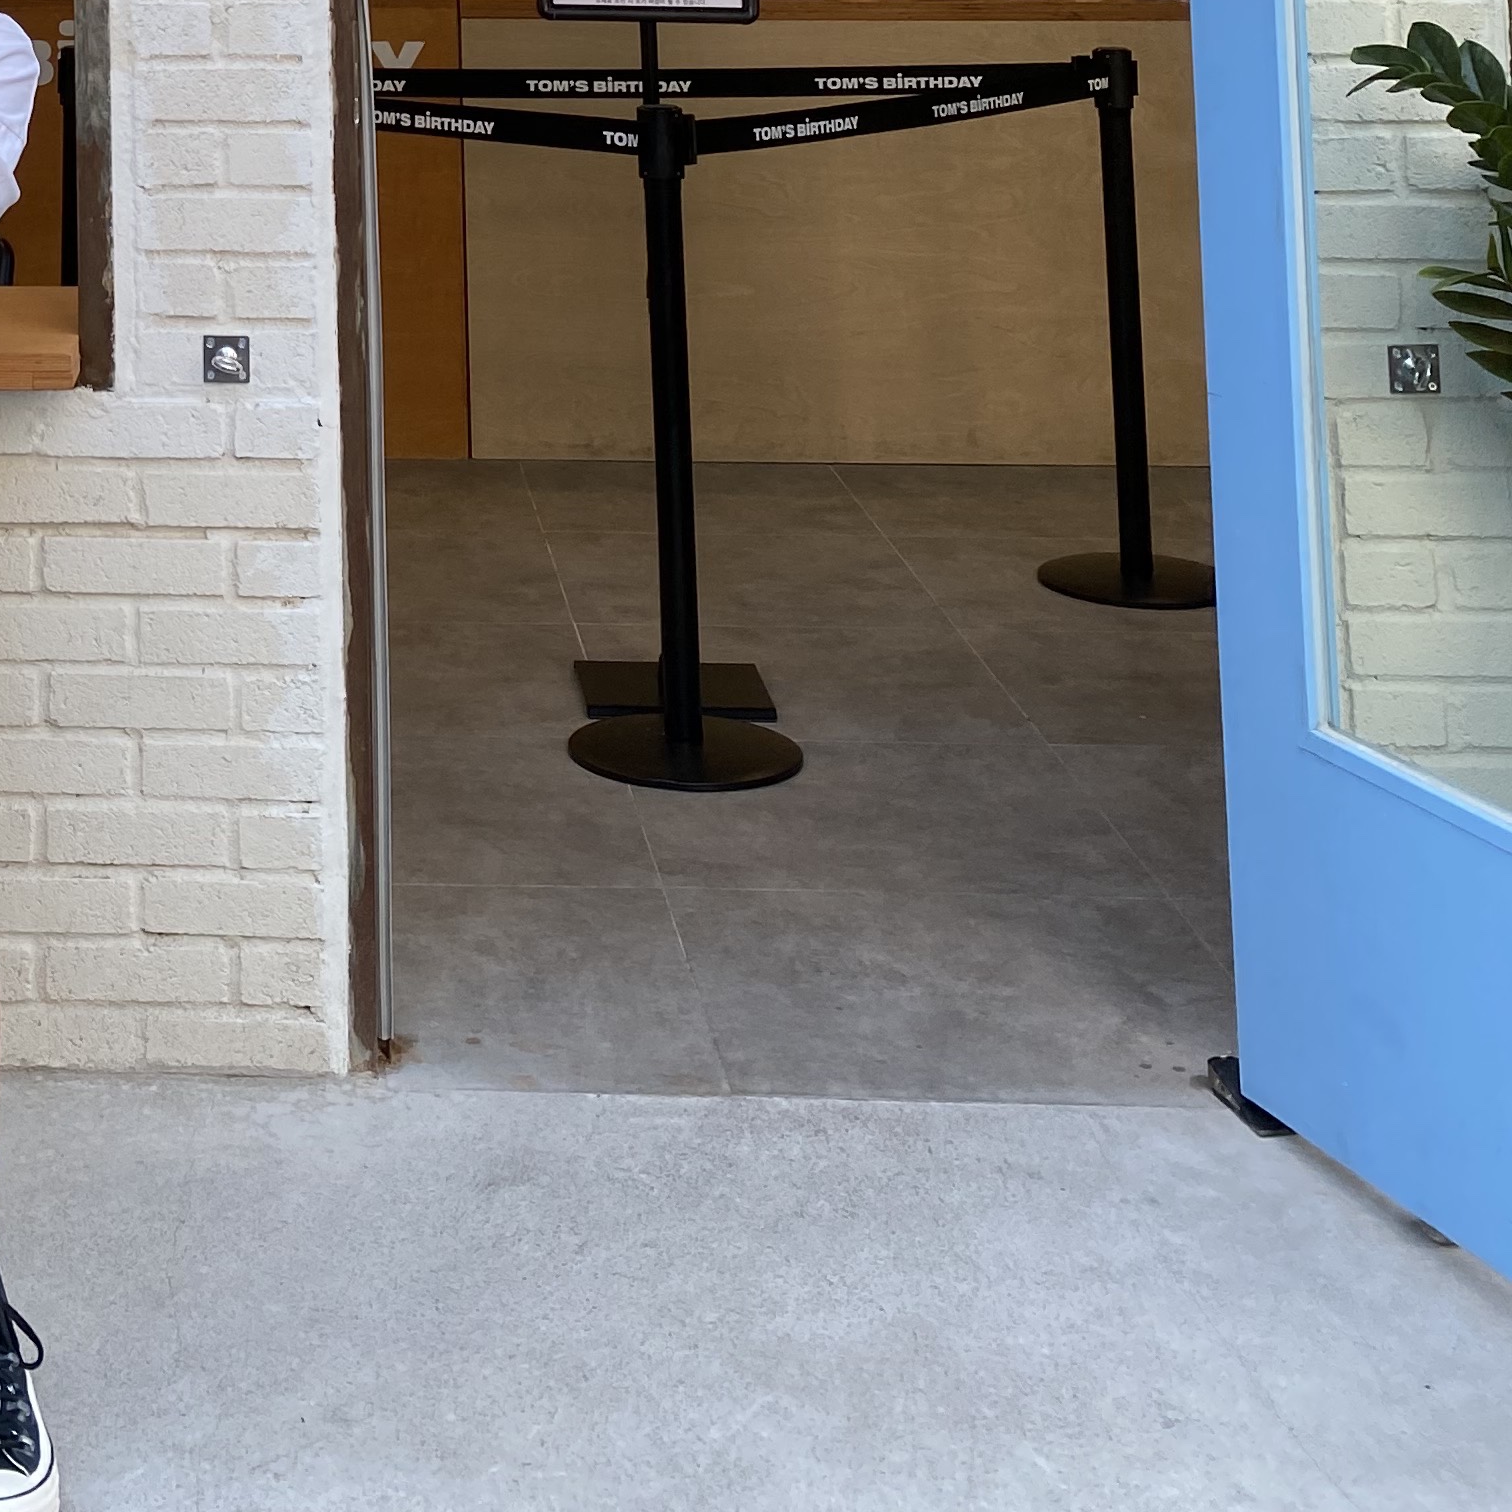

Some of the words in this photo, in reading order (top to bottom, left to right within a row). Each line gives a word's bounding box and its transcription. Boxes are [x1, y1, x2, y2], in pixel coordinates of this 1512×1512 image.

[525, 80, 589, 92] TOM'S
[815, 77, 879, 90] TOM'S
[932, 101, 968, 118] TOM'S
[753, 124, 795, 141] TOM'S
